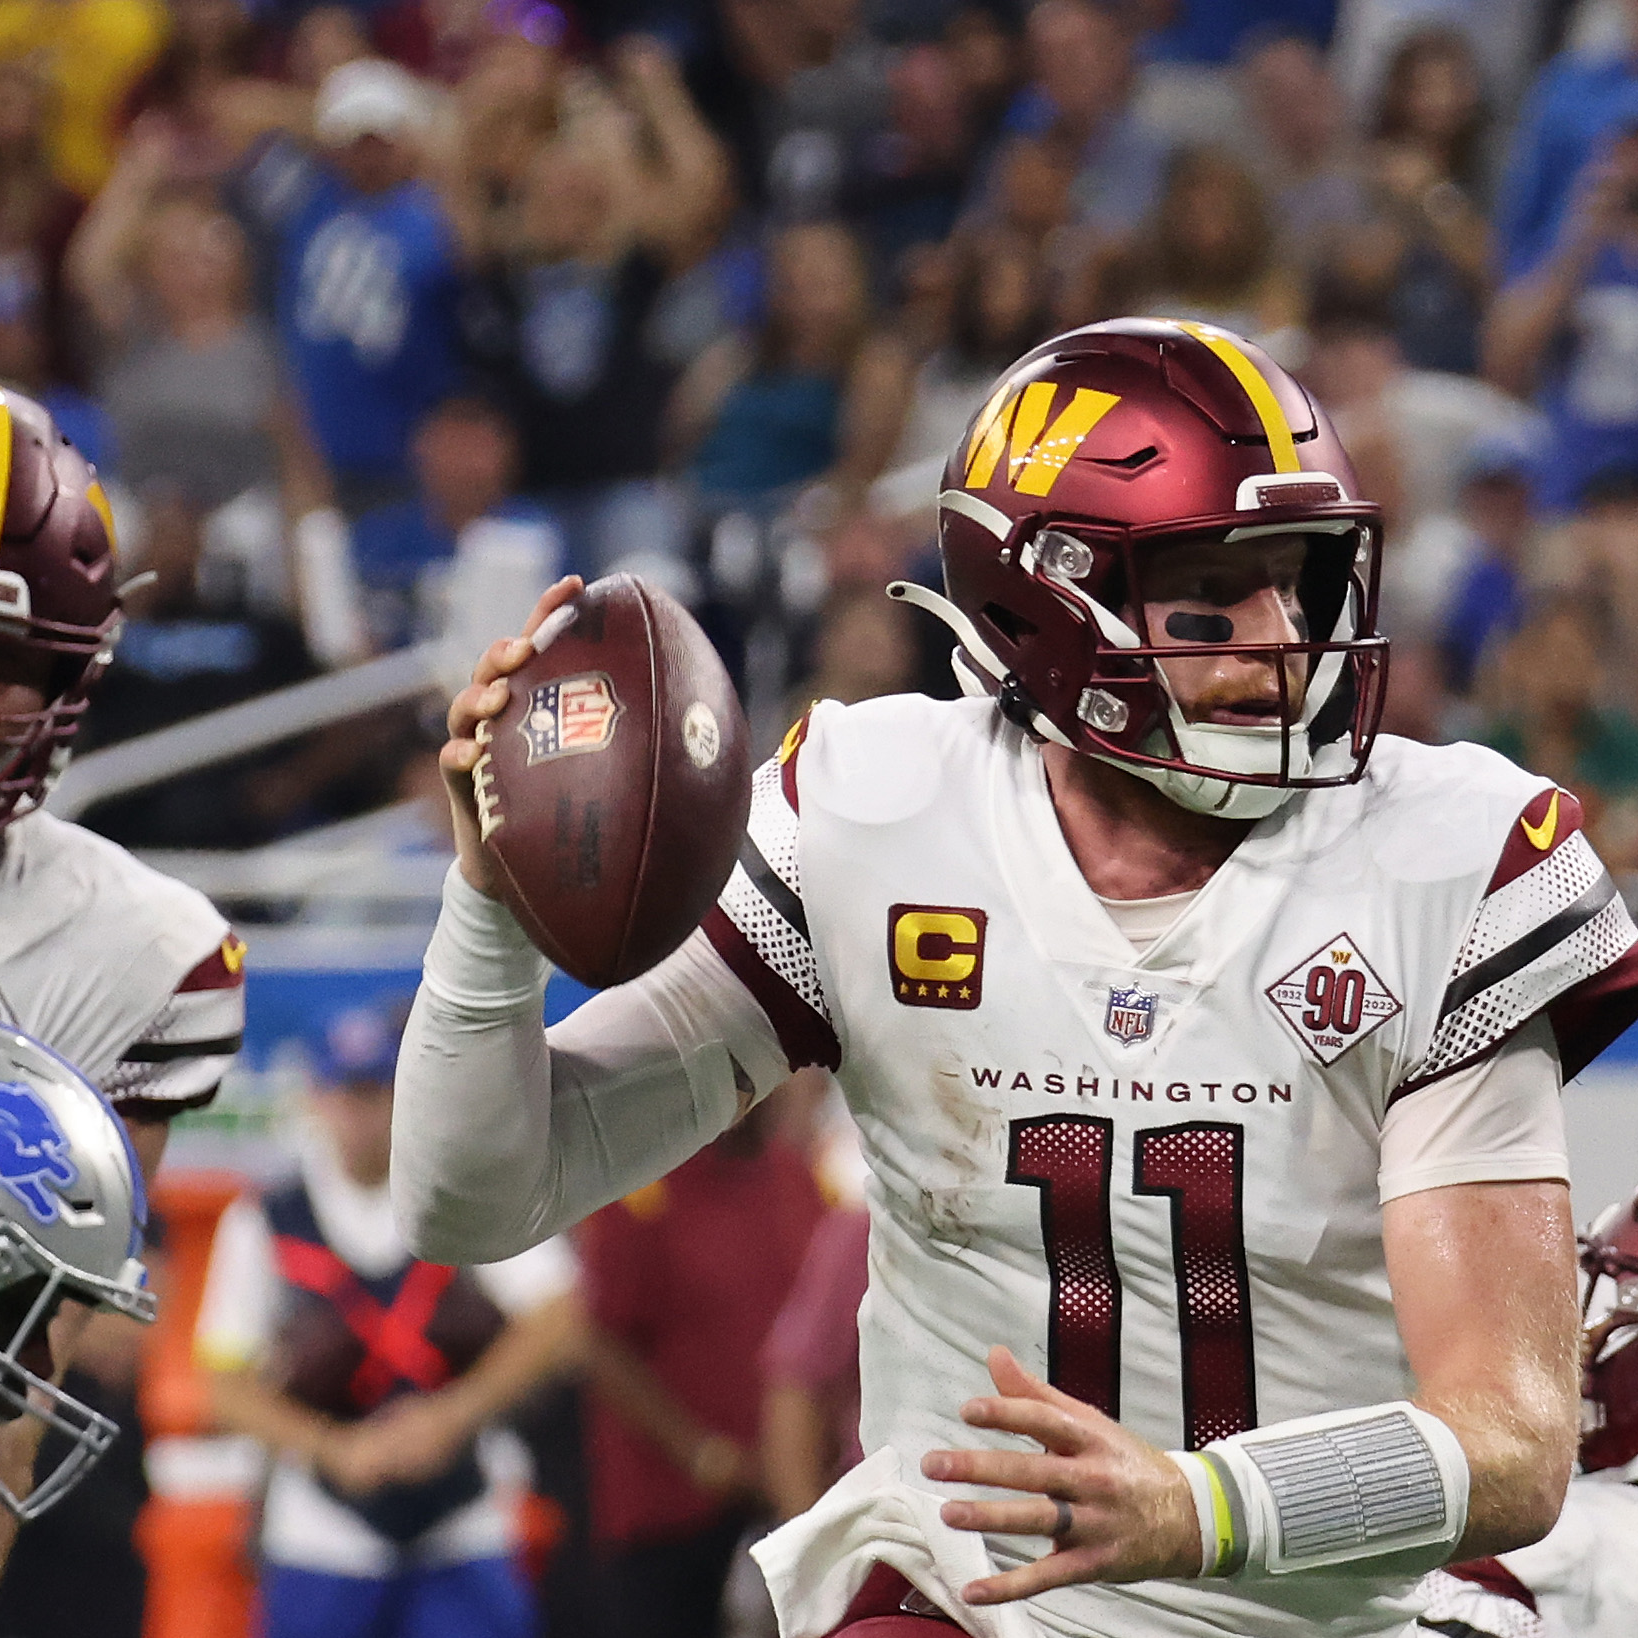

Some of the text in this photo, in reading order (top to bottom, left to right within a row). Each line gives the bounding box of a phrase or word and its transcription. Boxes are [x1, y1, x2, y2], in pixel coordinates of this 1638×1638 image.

[562, 678, 612, 746] NFL
[894, 912, 978, 981] C
[1111, 1010, 1147, 1035] NFL
[1276, 965, 1394, 1035] 1932 90 2022
[1312, 1033, 1344, 1049] YEARS
[972, 1066, 1293, 1103] WASHINGTON
[1004, 1112, 1258, 1452] 11
